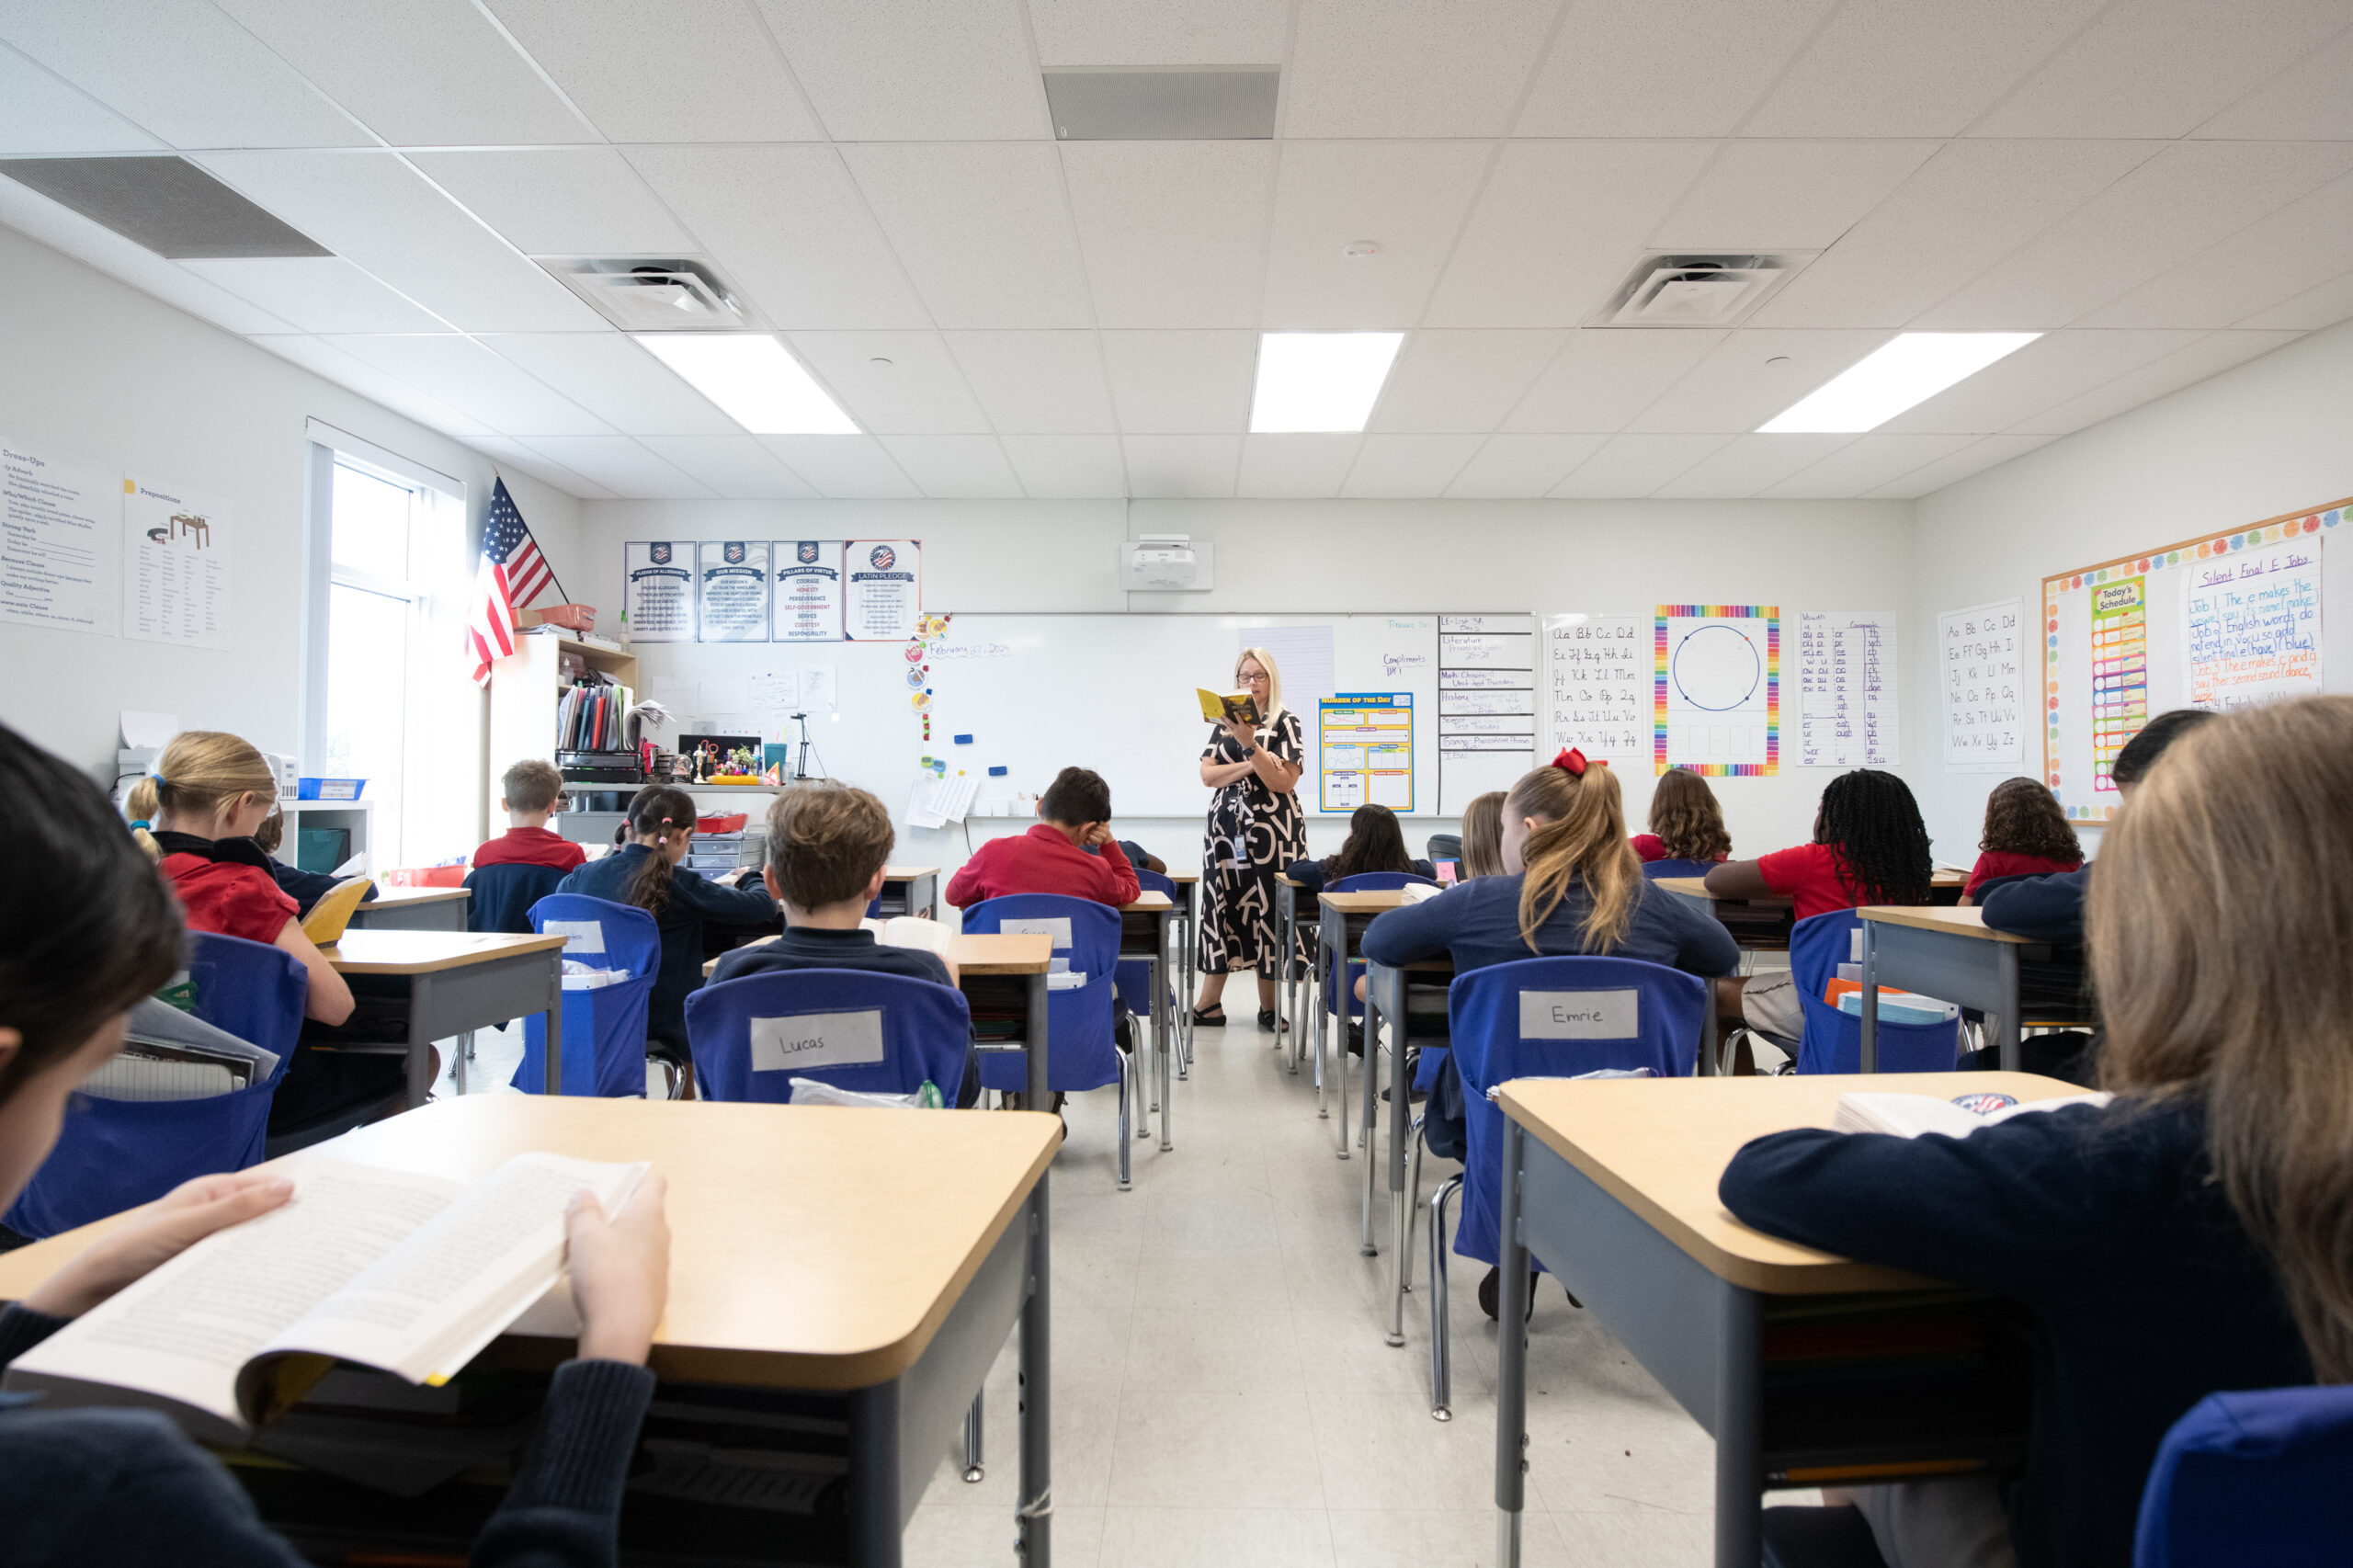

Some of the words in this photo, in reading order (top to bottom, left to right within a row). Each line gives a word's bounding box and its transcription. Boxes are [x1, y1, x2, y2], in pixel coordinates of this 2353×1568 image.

[3, 449, 45, 467] Dress-Ups
[3, 489, 37, 503] Who/Which
[38, 497, 56, 507] Clause
[141, 487, 181, 505] Prepositions
[2, 521, 22, 532] Strong
[2202, 567, 2234, 585] Silent
[2241, 559, 2263, 577] Final
[2271, 558, 2279, 571] E
[2285, 554, 2309, 568] Jobs
[0, 580, 23, 592] Quality
[2102, 585, 2132, 599] Today's
[2099, 596, 2136, 610] Schedule
[2190, 598, 2210, 614] Job
[2224, 591, 2243, 608] The
[2247, 593, 2256, 604] e
[2258, 582, 2290, 602] makes
[2294, 578, 2312, 596] the
[1802, 613, 1825, 621] Vowels
[2191, 608, 2219, 625] vowel
[2222, 608, 2240, 621] say
[2226, 611, 2260, 636] English
[2262, 608, 2295, 627] words
[2300, 602, 2313, 620] do
[1948, 627, 1960, 638] Aa
[1965, 622, 1976, 635] Bb
[1984, 619, 1995, 631] Cc
[2002, 614, 2016, 629] Dd
[2262, 631, 2273, 641] so
[2275, 620, 2295, 639] add
[929, 642, 968, 656] February
[1949, 647, 1960, 660] Ee
[1963, 644, 1973, 658] Ff
[1975, 643, 1987, 660] Gg
[1989, 641, 2001, 653] Hh
[2006, 638, 2014, 652] Ii
[2192, 646, 2217, 663] silent
[1383, 653, 1427, 666] Compliments
[2222, 657, 2240, 671] The
[2248, 654, 2277, 669] makes
[1951, 669, 1961, 687] Jj
[1969, 667, 1978, 680] Kk
[1987, 665, 1995, 677] Ll
[2001, 663, 2016, 676] Mm
[1950, 691, 1961, 703] Nn
[1967, 689, 1979, 702] Oo
[1985, 687, 1995, 705] Pp
[2002, 685, 2015, 703] Qq
[2195, 680, 2211, 692] say
[1441, 690, 1470, 701] History
[1952, 713, 1962, 725] Rr
[1965, 712, 1975, 724] Ss
[1978, 710, 1987, 723] Tt
[1990, 710, 2002, 722] Uu
[2004, 708, 2016, 722] Vv
[1952, 735, 1968, 747] Ww
[1972, 733, 1982, 746] Xx
[1986, 733, 1998, 750] Yy
[2003, 732, 2015, 745] Zz
[1552, 1006, 1604, 1024] Emrie
[779, 1037, 825, 1055] Lucas
